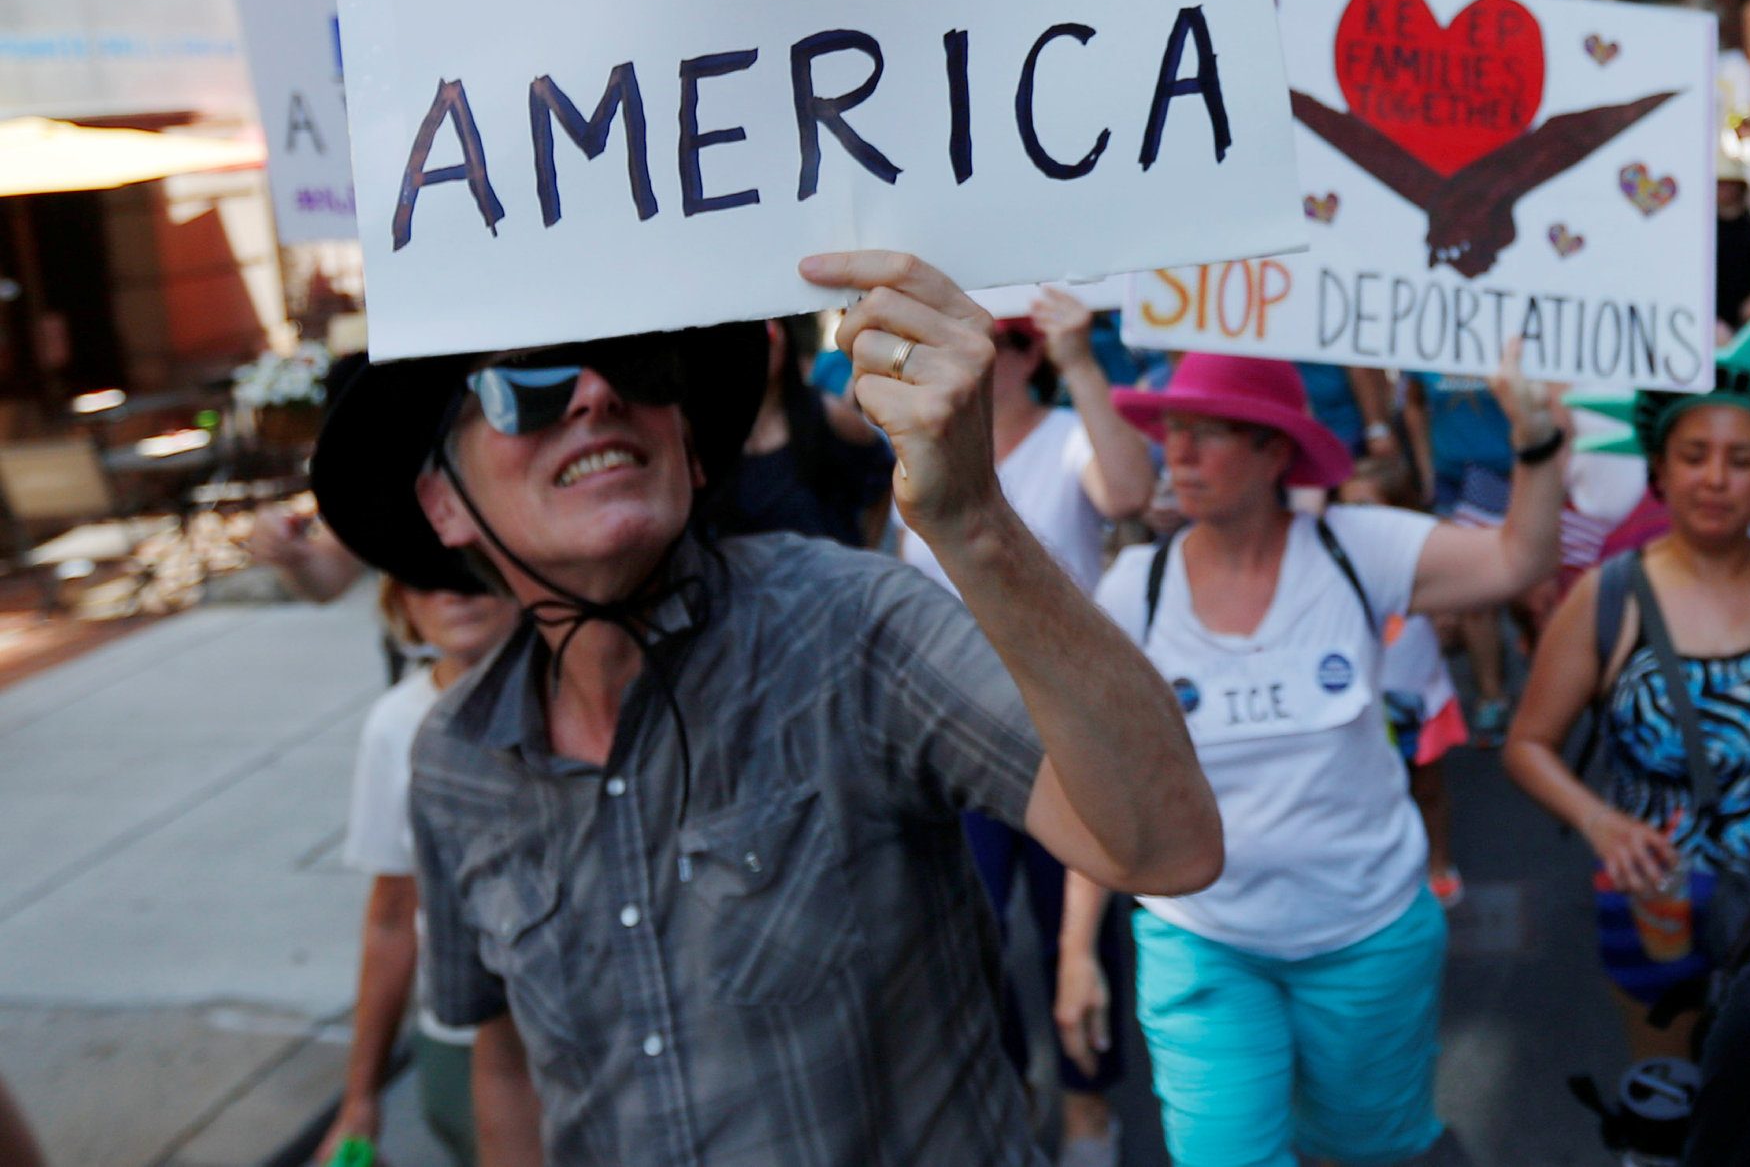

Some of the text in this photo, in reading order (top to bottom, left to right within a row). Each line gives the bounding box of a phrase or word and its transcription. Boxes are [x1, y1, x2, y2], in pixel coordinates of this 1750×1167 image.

[1344, 40, 1526, 95] FAMILIES
[392, 4, 1231, 251] AMERICA
[1353, 84, 1528, 131] TOGETHER
[1316, 268, 1701, 384] DEPORTATIONS
[1222, 681, 1293, 726] ICE
